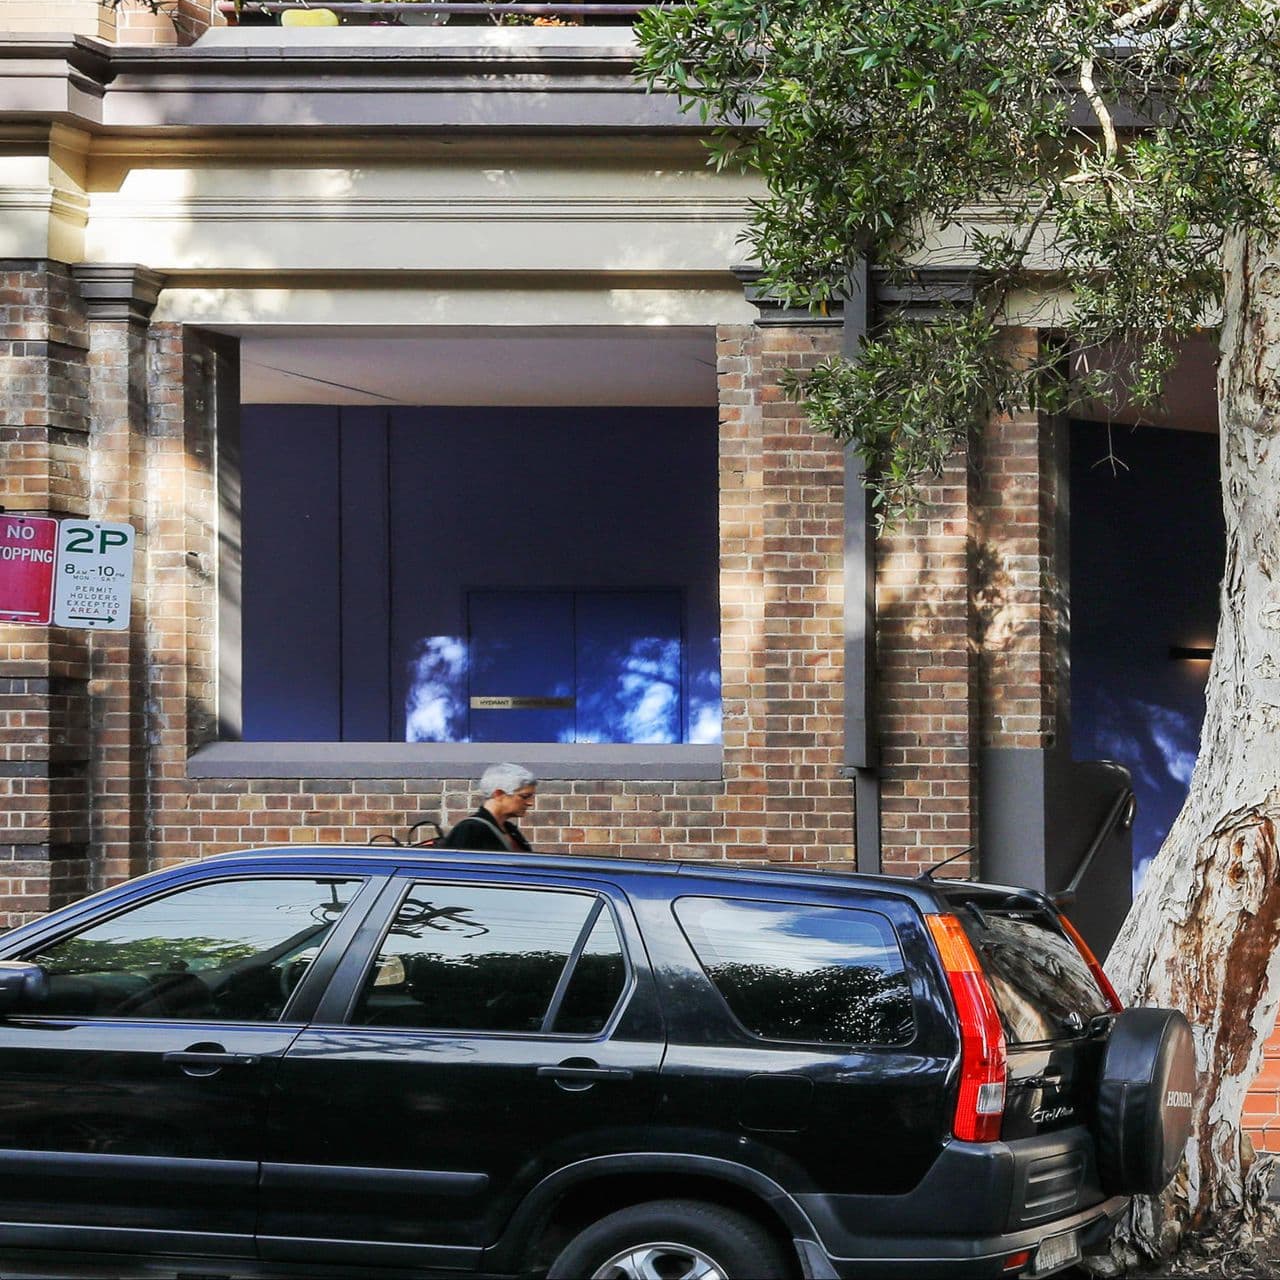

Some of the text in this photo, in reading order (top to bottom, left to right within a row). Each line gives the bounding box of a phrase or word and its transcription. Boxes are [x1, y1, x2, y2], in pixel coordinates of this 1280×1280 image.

[7, 524, 35, 540] NO
[65, 527, 128, 554] 2P
[0, 546, 53, 563] OPPING
[66, 600, 120, 609] EXCEPTED
[70, 593, 118, 601] HOLDERS
[1167, 1091, 1192, 1107] HONDA
